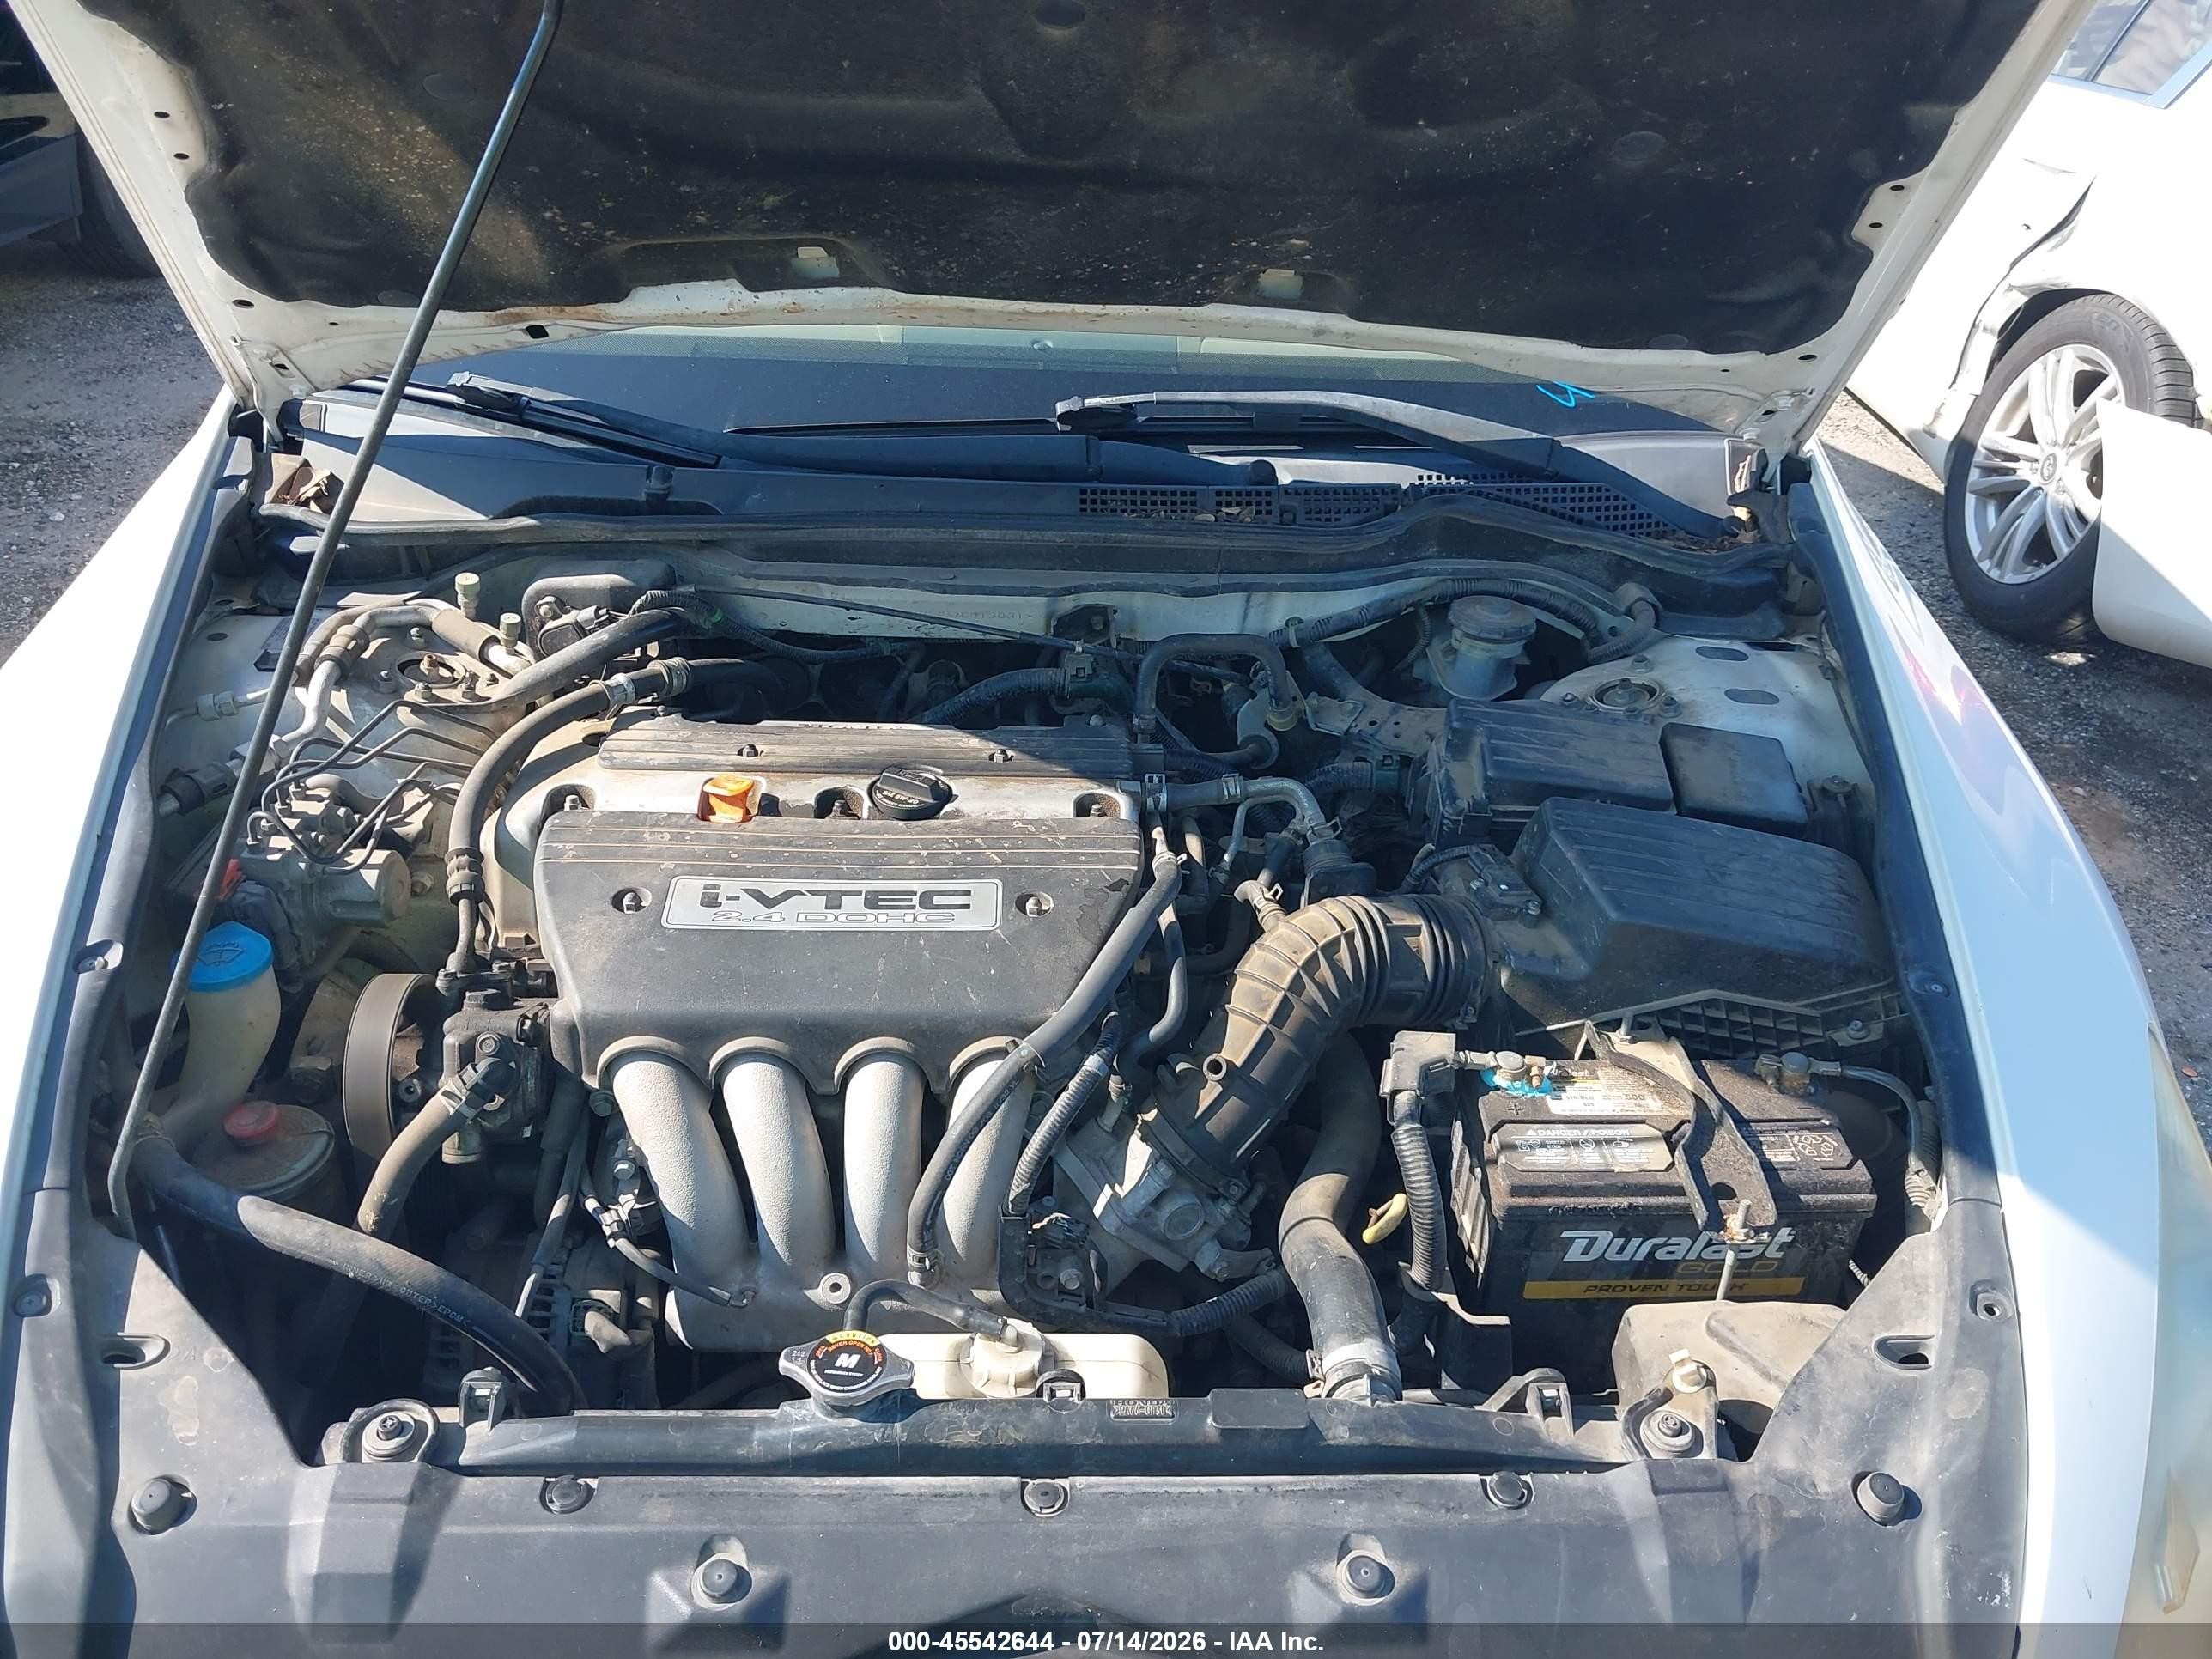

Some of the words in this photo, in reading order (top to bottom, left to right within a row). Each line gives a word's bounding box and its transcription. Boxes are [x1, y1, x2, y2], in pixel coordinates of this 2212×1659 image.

[881, 789, 896, 799] SAE
[699, 884, 972, 910] i-VTEC
[712, 910, 786, 923] 2.4
[795, 911, 956, 924] DOHC
[1559, 1226, 1797, 1262] Duralast
[1583, 1284, 1670, 1295] PROVEN
[1676, 1282, 1745, 1292] TOUH
[827, 1340, 848, 1352] NEVER
[848, 1340, 866, 1349] OPEN
